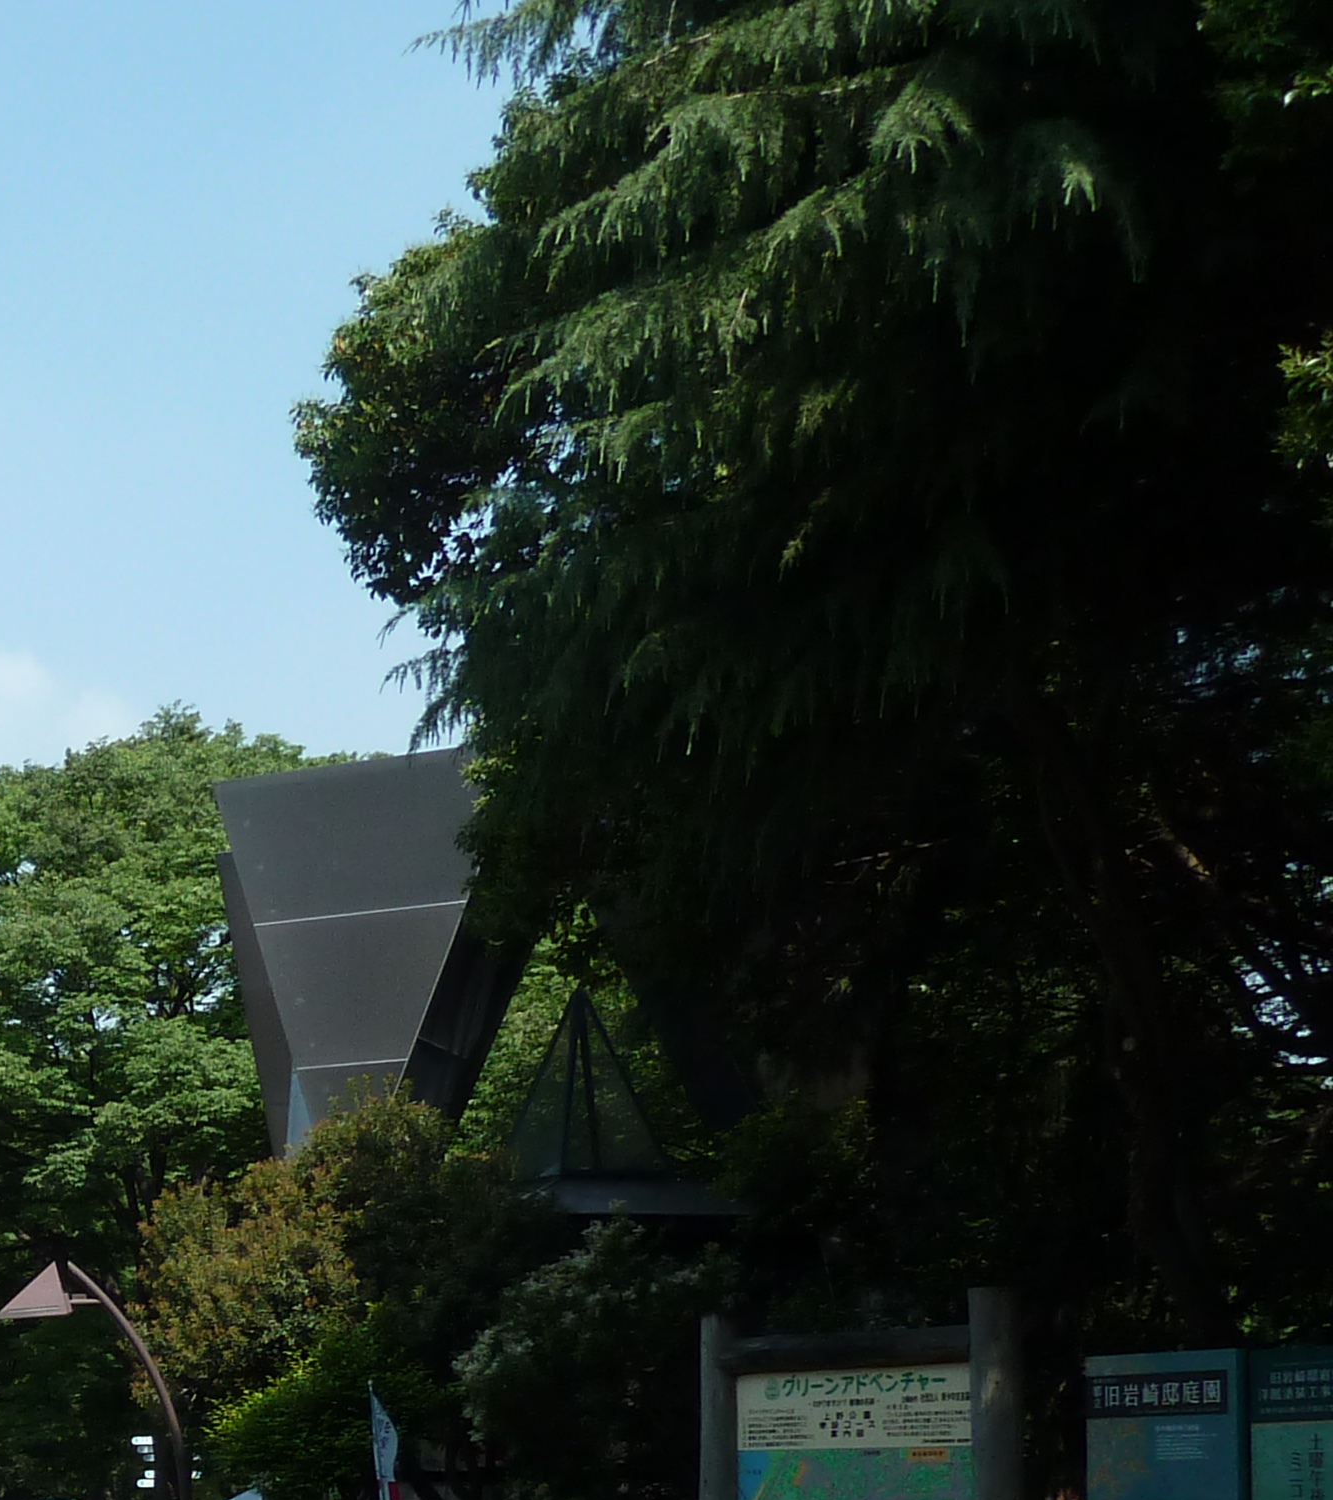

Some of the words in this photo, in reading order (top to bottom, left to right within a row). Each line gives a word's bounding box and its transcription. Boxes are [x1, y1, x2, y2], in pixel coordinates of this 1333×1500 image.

[782, 1371, 947, 1397] グリーンアドベンチャー
[1269, 1368, 1333, 1384] 旧岩崎邸庭
[1104, 1379, 1221, 1407] 旧岩崎邸庭園
